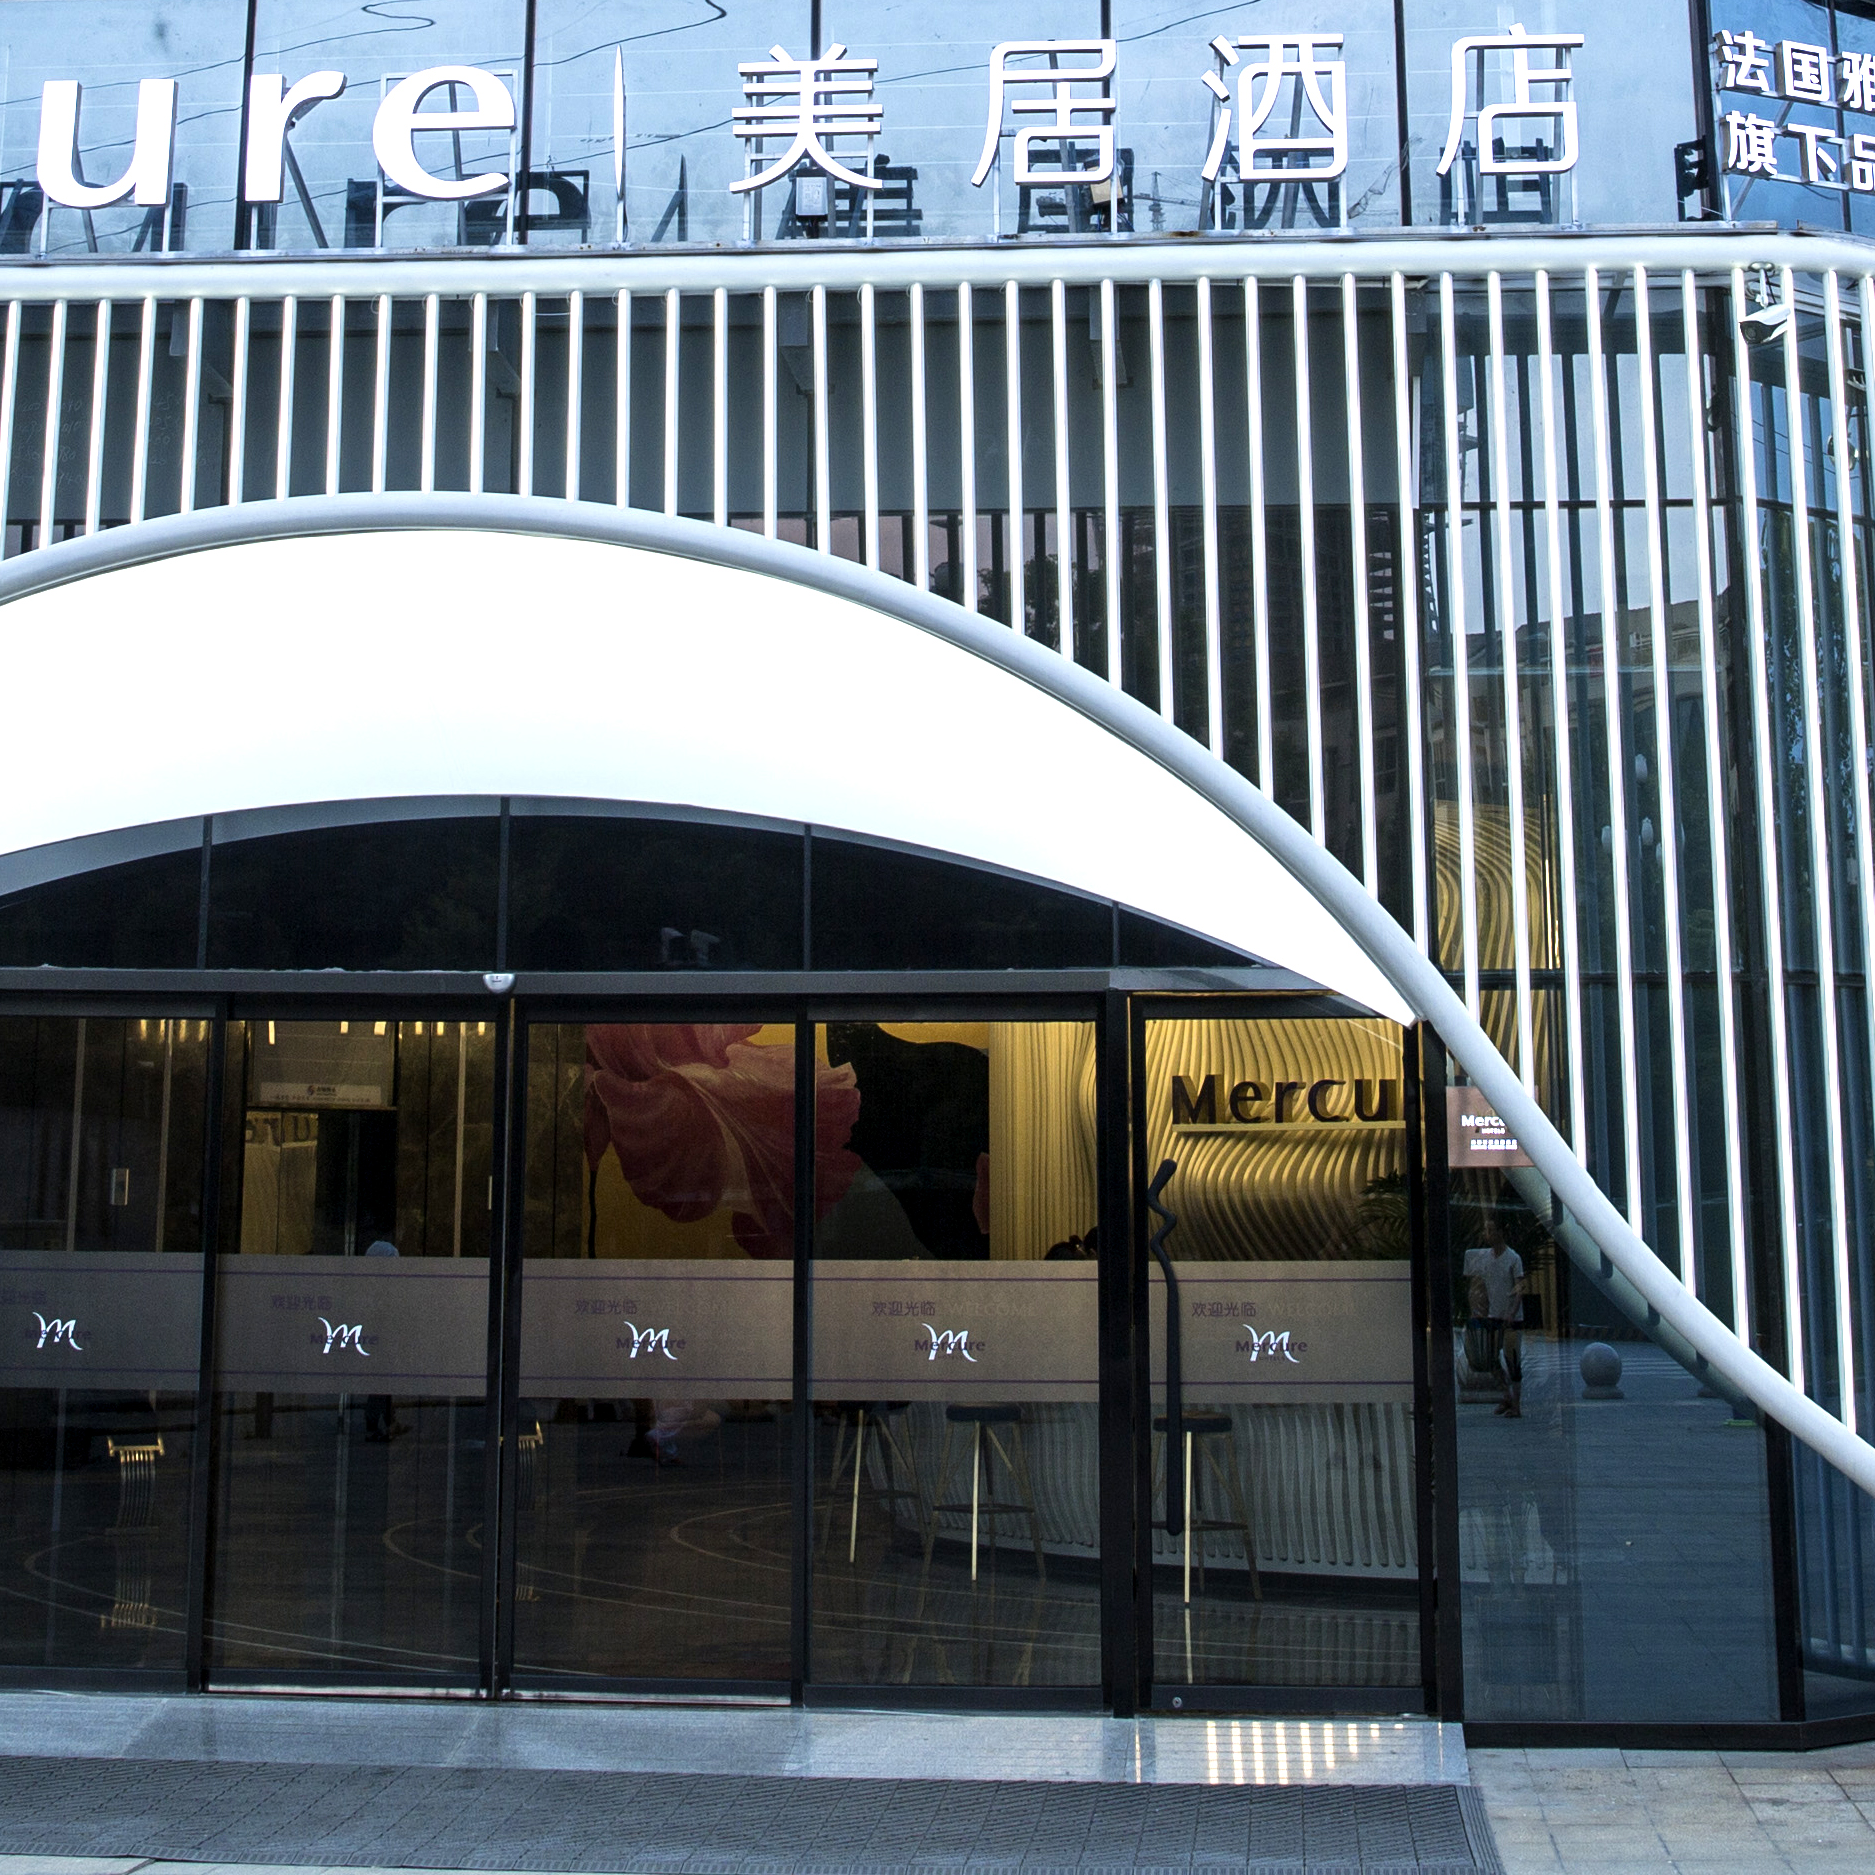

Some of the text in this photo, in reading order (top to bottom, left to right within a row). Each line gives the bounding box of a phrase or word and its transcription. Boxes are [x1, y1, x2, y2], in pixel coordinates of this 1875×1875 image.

[729, 22, 1585, 192] 美居酒店
[1171, 1074, 1399, 1125] Mercu
[1461, 1114, 1506, 1127] Merc
